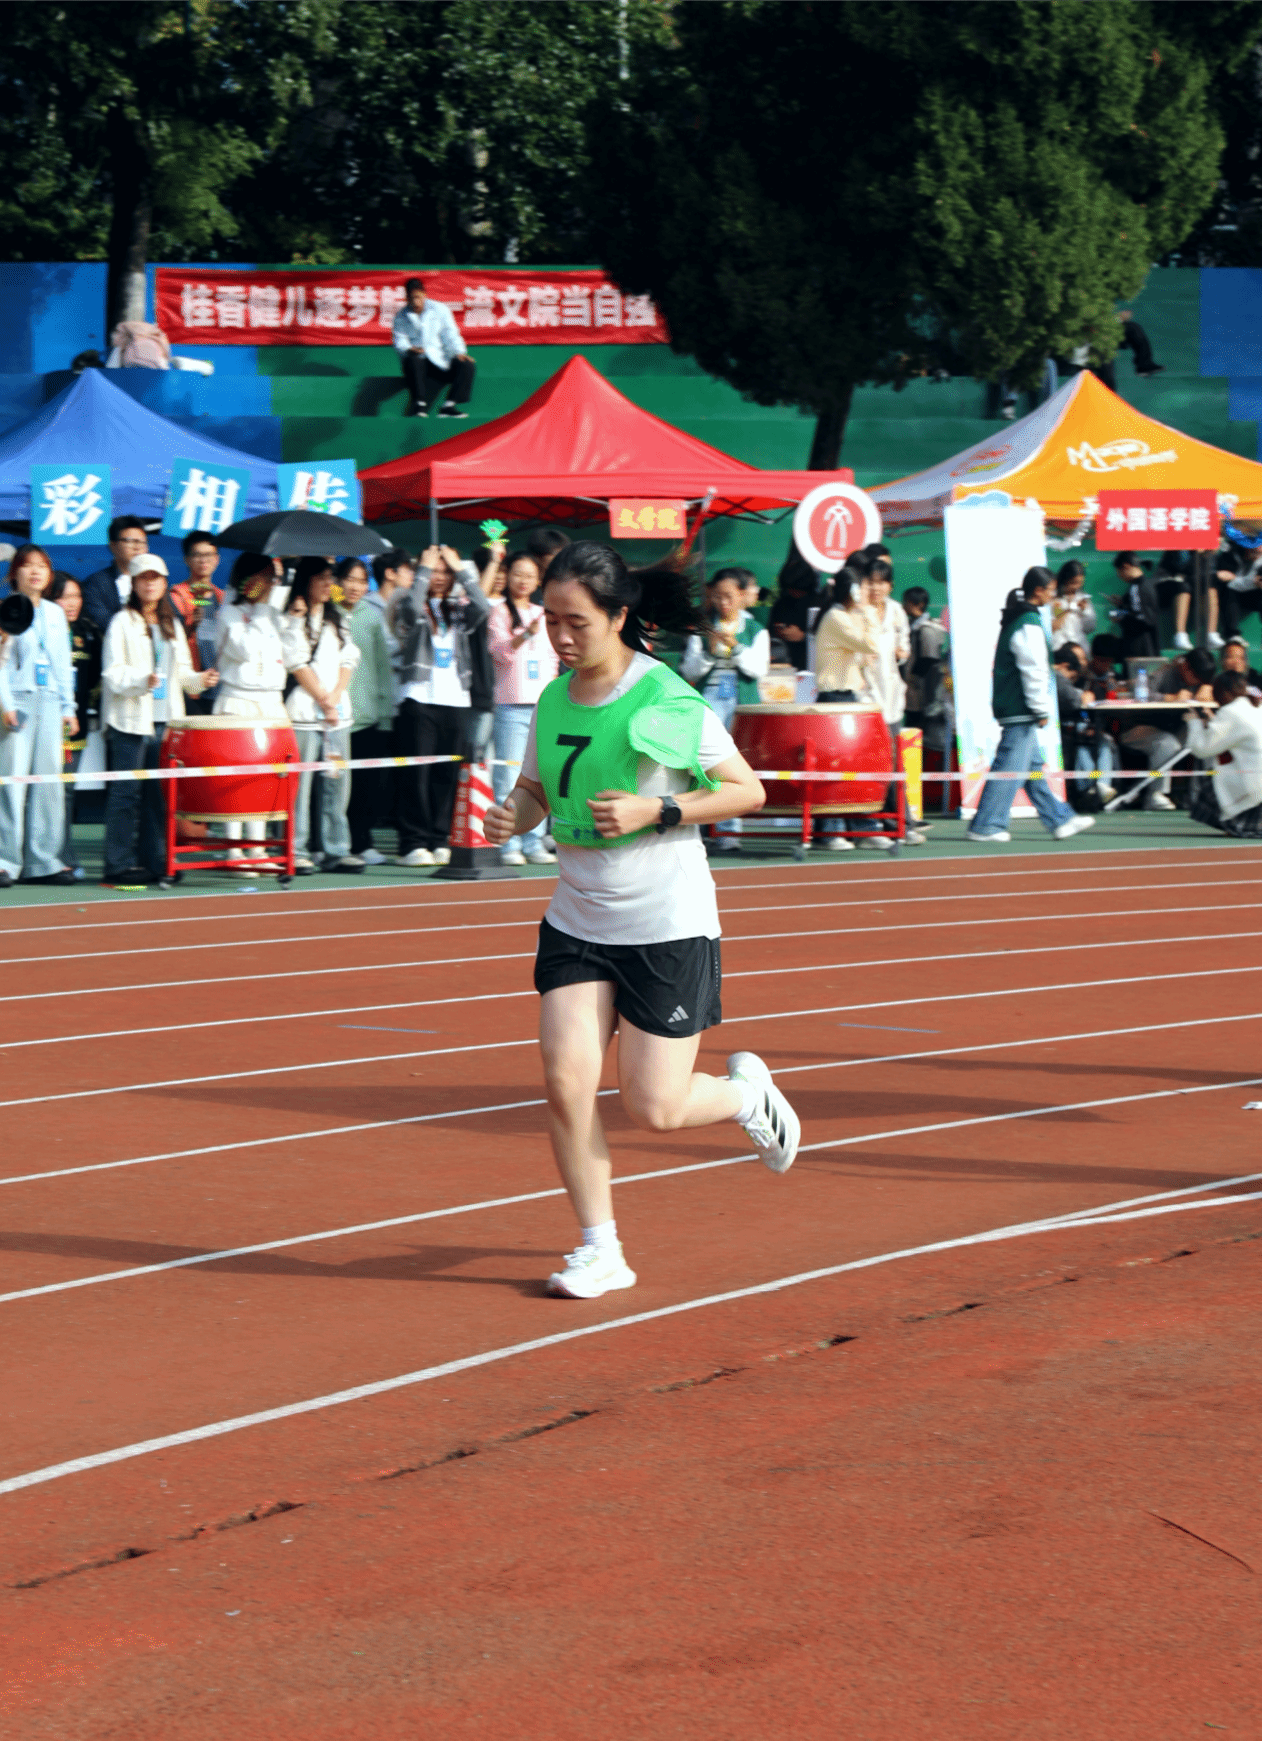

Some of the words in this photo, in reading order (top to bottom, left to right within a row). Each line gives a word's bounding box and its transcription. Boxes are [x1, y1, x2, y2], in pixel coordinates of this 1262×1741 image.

[38, 473, 104, 536] 彩
[173, 467, 241, 533] 相
[1105, 507, 1211, 532] 外国语学院
[556, 734, 592, 799] 7
